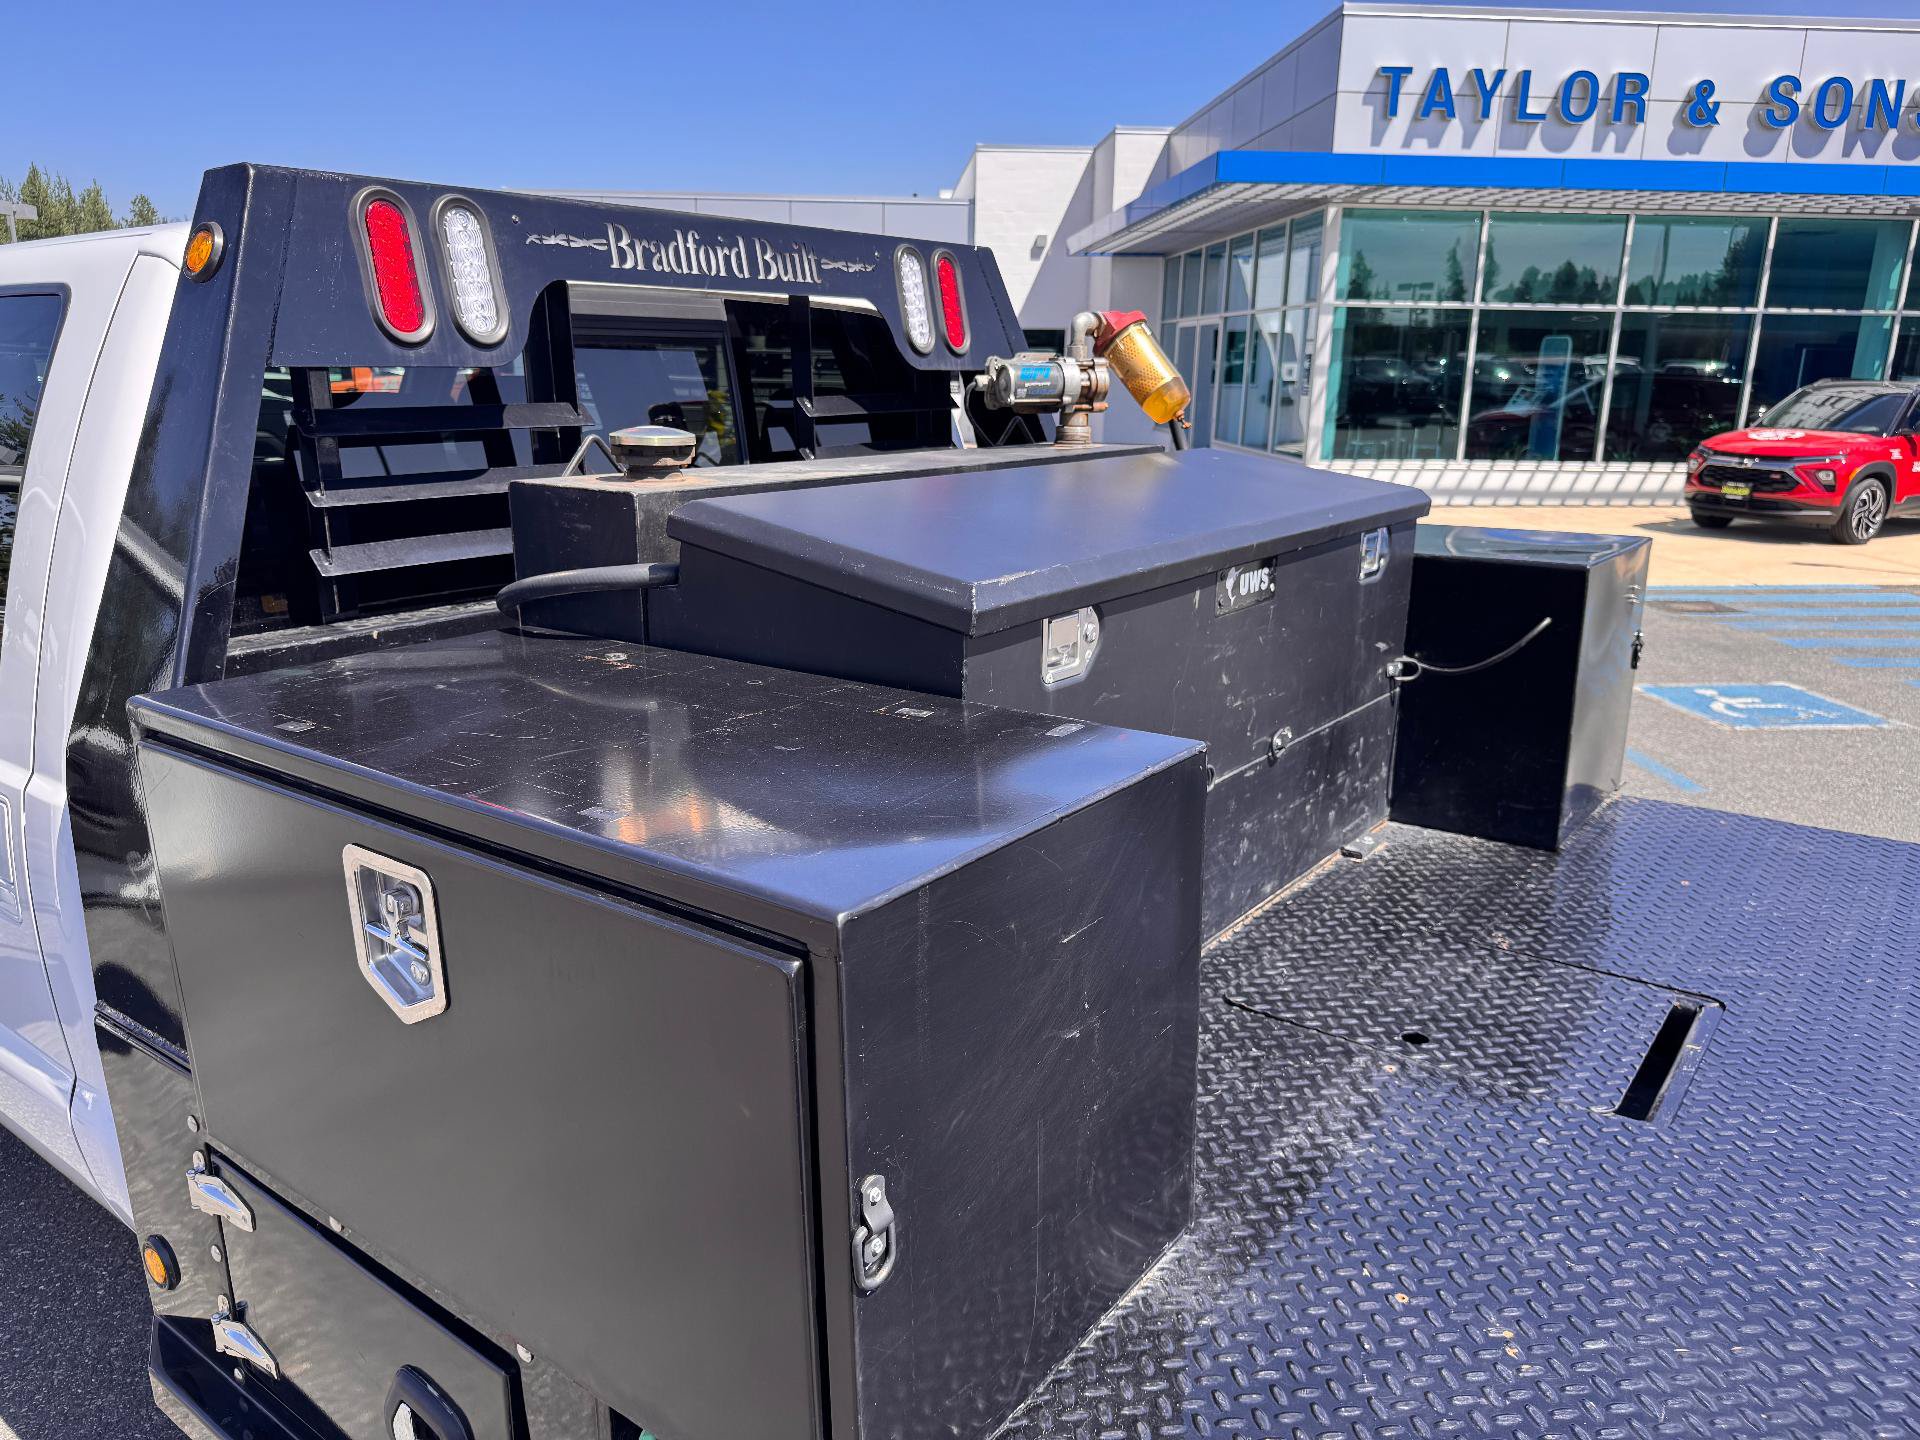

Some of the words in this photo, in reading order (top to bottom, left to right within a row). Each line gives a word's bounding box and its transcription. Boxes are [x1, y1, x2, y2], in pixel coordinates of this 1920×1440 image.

[1378, 65, 1650, 125] TAYLOR
[1687, 78, 1721, 128] &
[1764, 74, 1920, 130] SON
[604, 222, 752, 279] Bradford
[752, 237, 823, 284] Built
